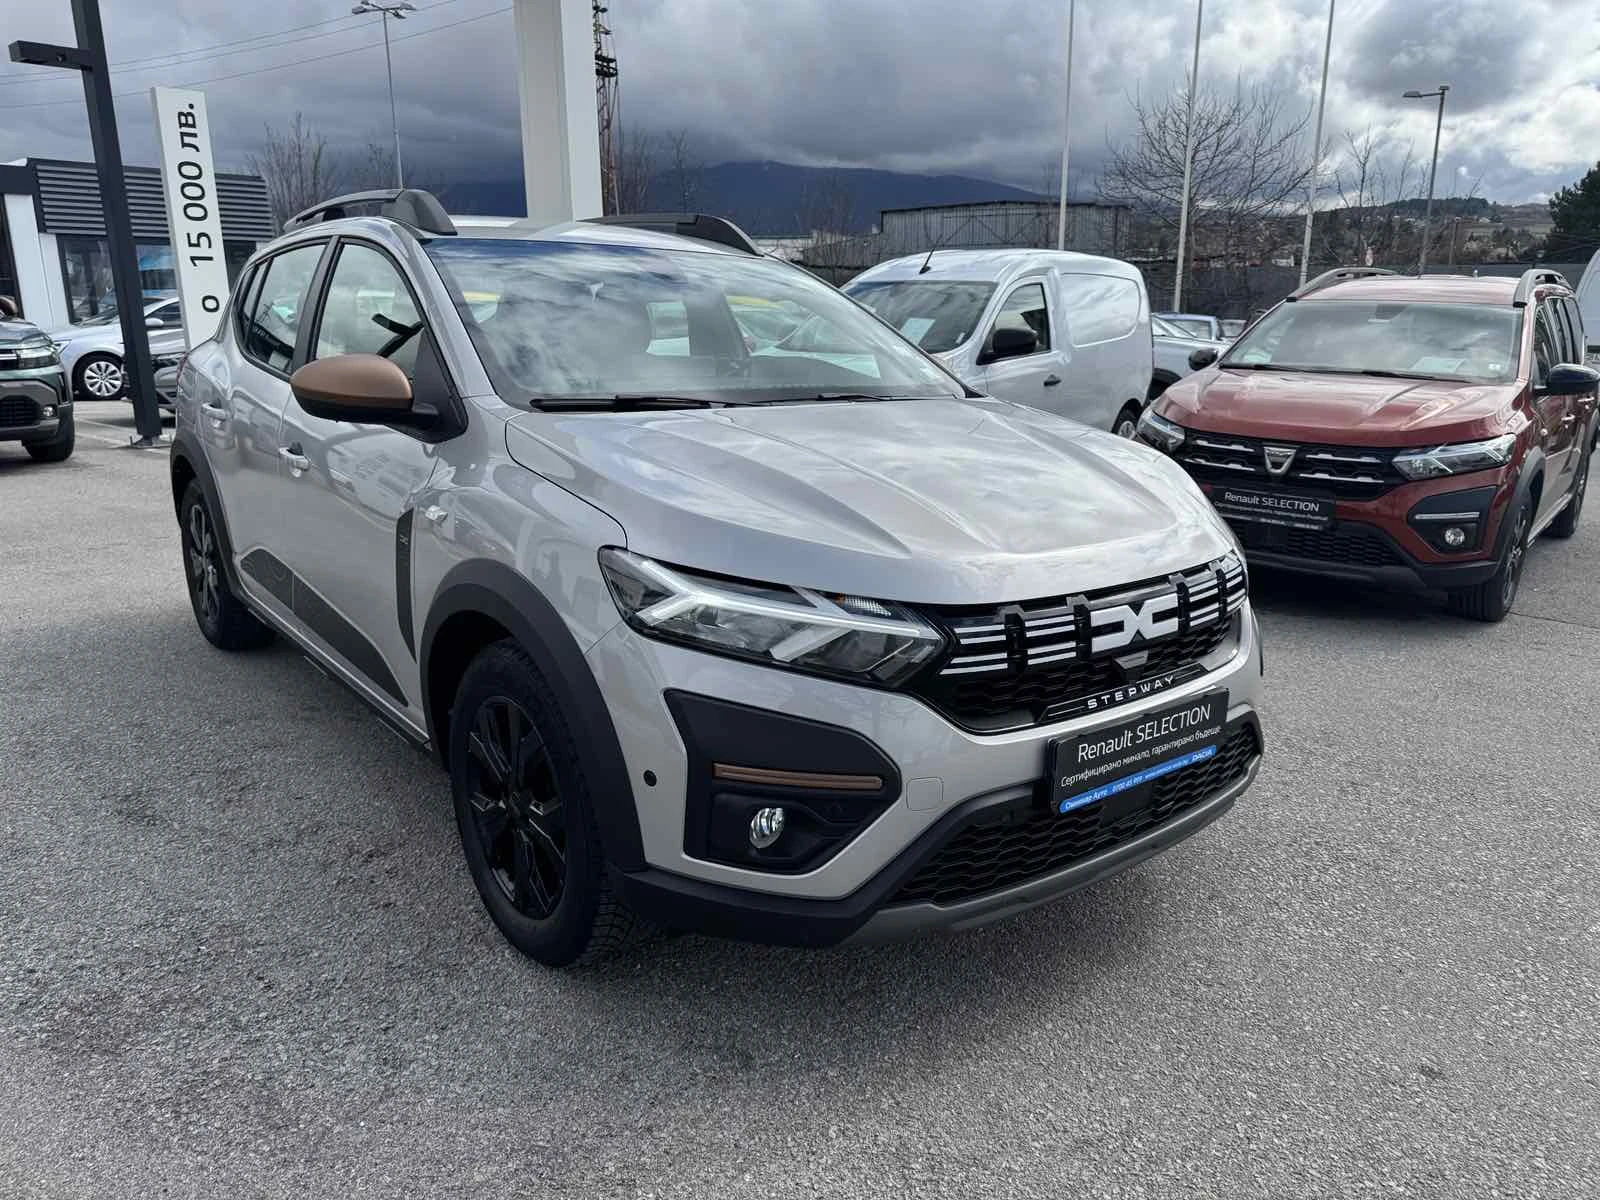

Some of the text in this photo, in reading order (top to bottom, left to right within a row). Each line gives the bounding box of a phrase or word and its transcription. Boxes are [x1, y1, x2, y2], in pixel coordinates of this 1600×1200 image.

[177, 103, 200, 152] лв.
[178, 161, 208, 222] 000
[187, 232, 214, 267] 15
[1224, 491, 1260, 505] Renault
[1262, 497, 1320, 512] SELECTION
[1087, 675, 1175, 710] STEPWAY
[1077, 703, 1211, 763] Renault SELECTION
[1061, 759, 1122, 787] Сертифицирано
[1151, 734, 1195, 756] гарантирано
